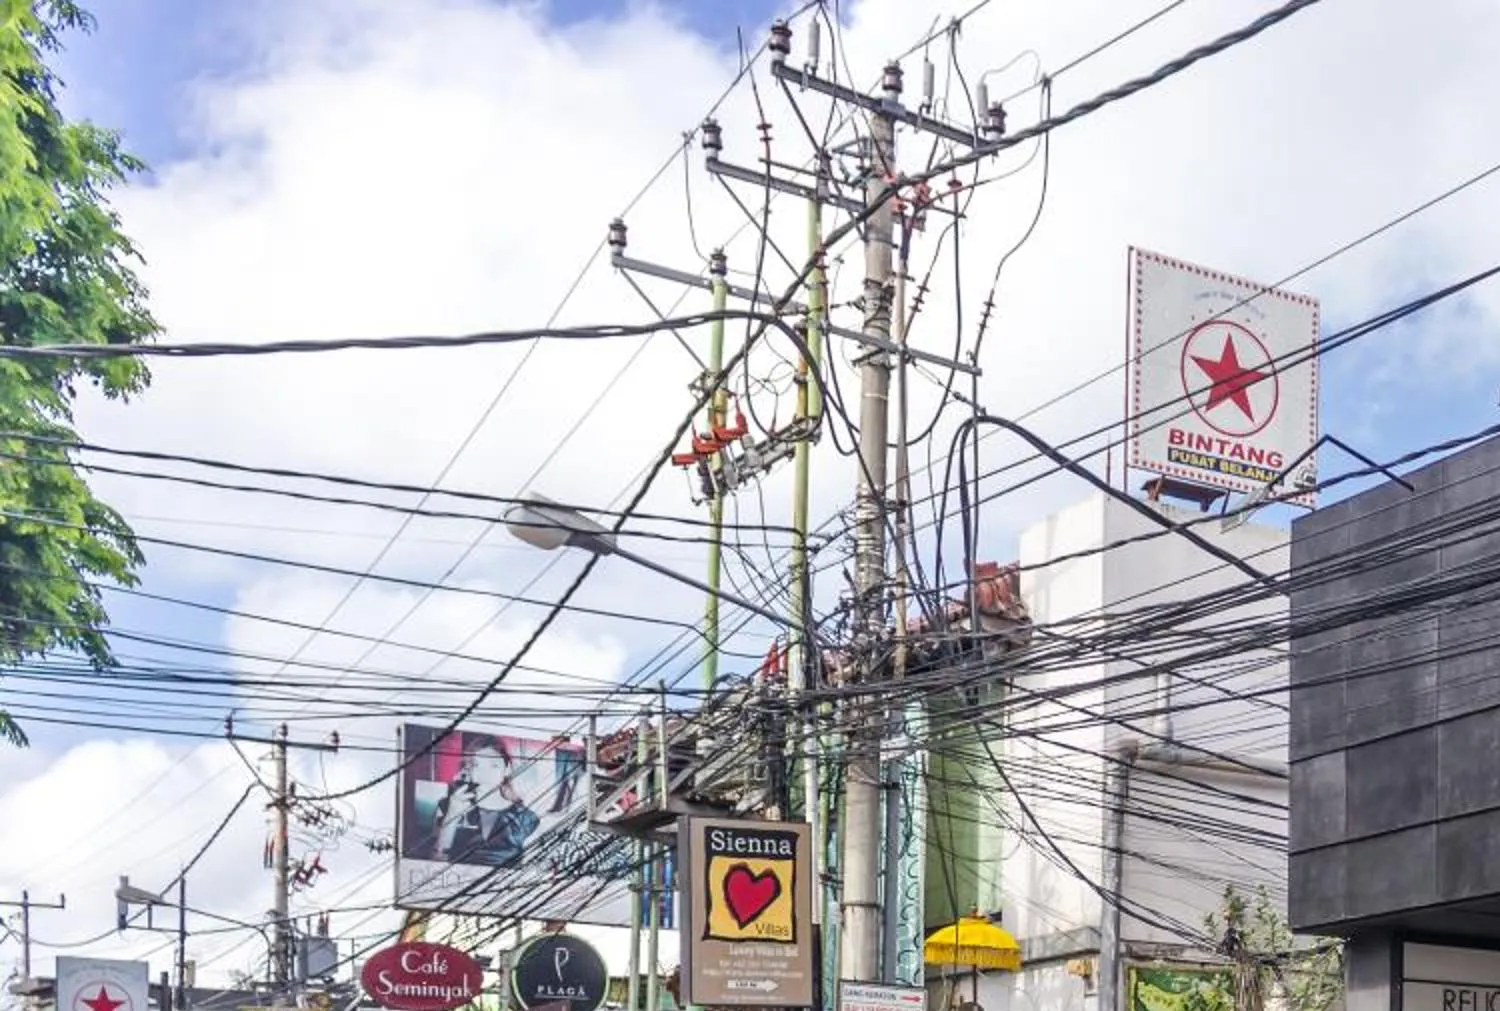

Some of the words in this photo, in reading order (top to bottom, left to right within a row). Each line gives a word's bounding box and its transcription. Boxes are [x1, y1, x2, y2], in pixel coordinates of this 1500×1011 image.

[1169, 428, 1283, 468] BINTANG
[1171, 449, 1217, 470] PUSAT
[711, 830, 793, 855] Sienna
[755, 923, 790, 937] Villas
[401, 950, 449, 975] Café
[376, 970, 473, 1002] Seminyak
